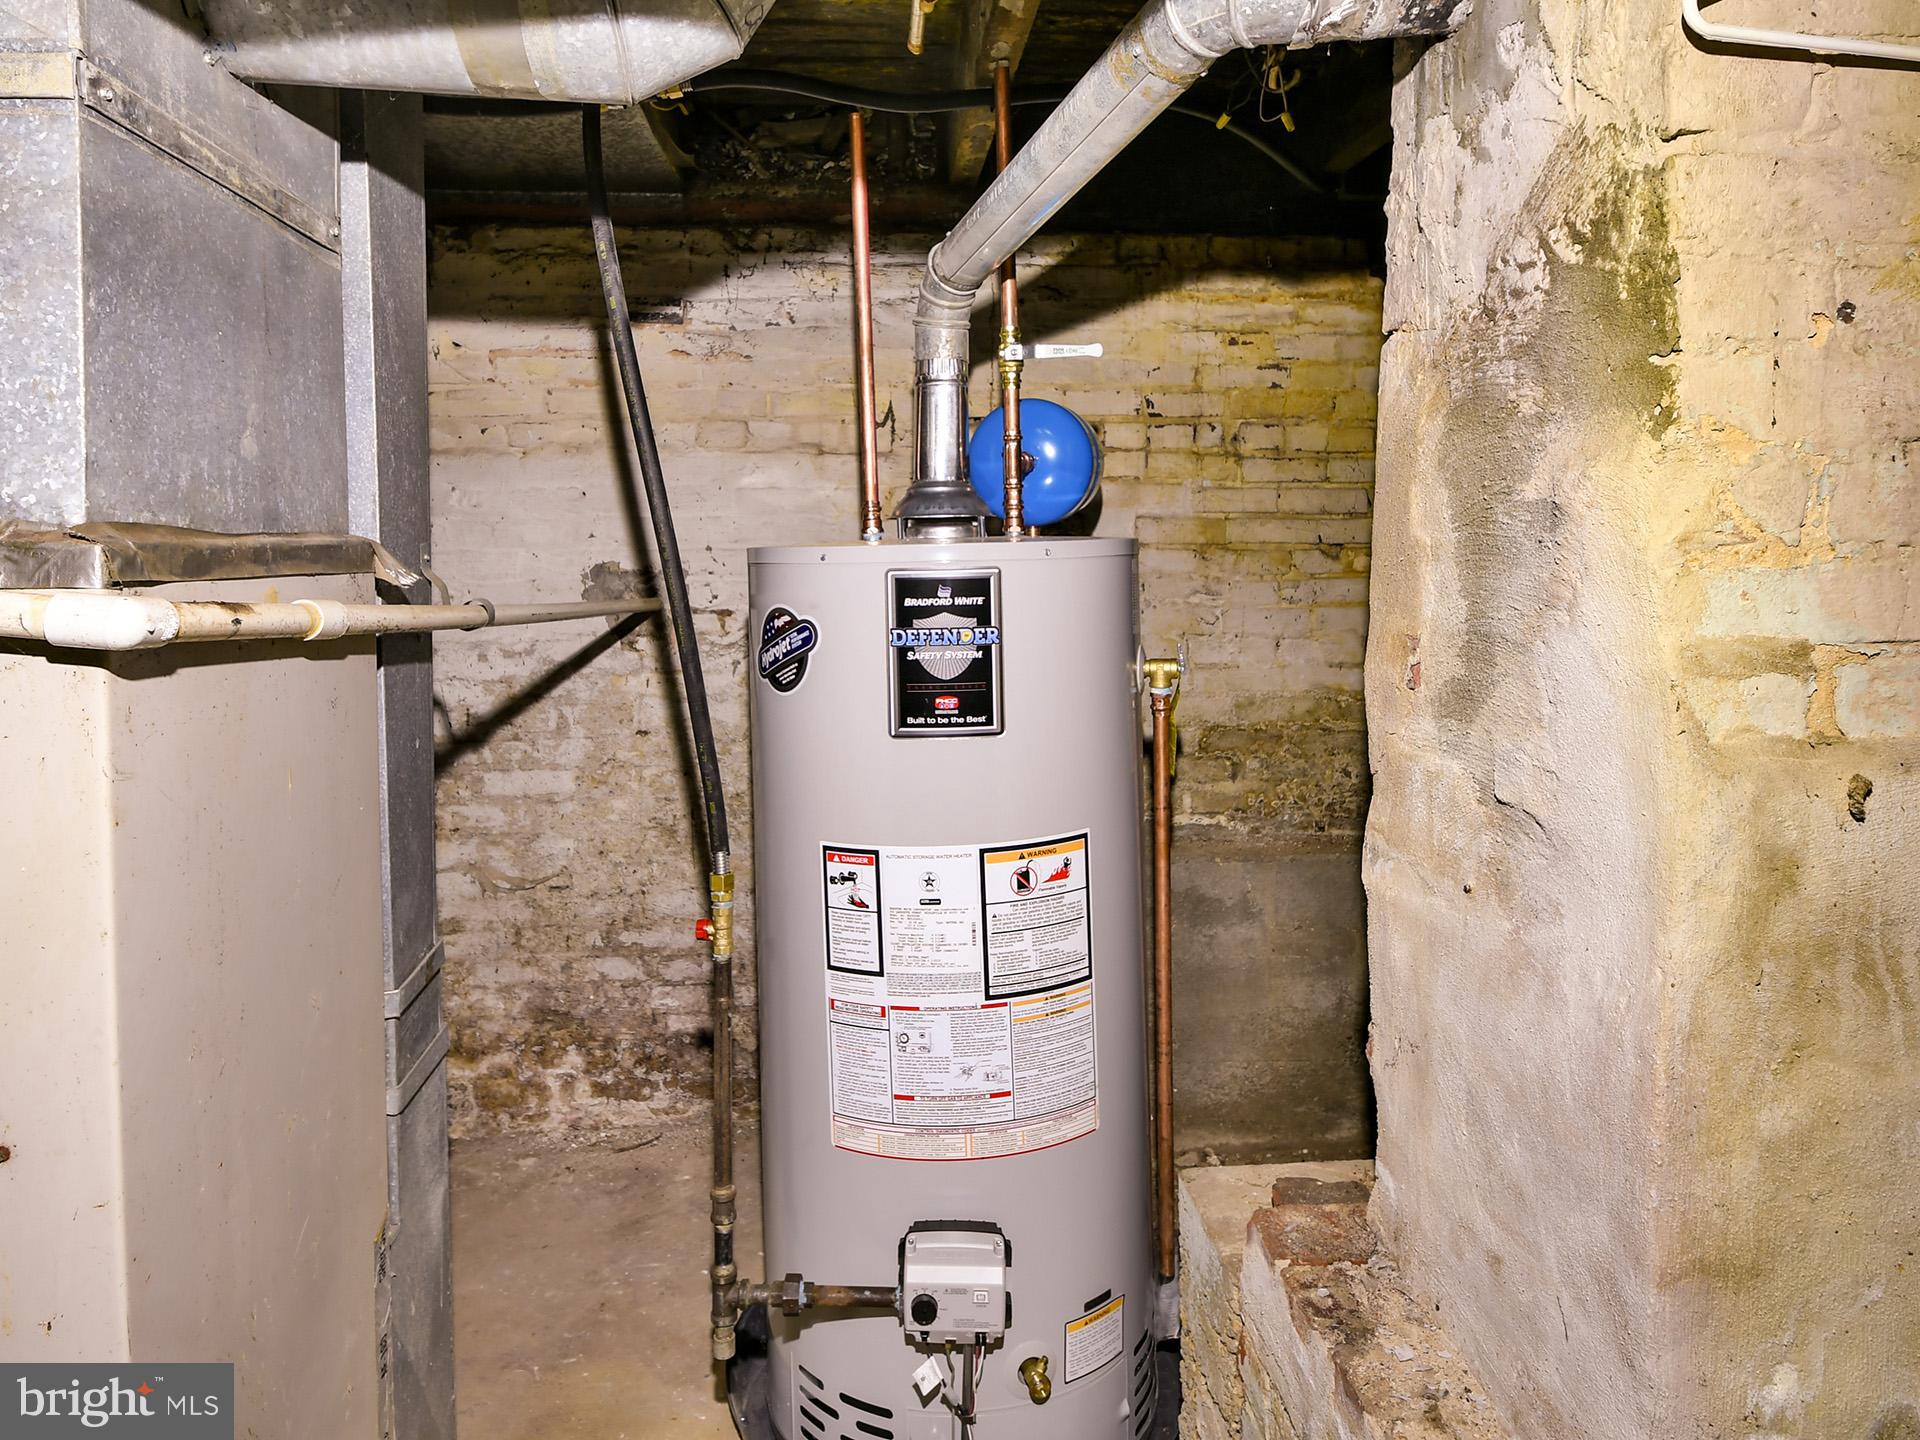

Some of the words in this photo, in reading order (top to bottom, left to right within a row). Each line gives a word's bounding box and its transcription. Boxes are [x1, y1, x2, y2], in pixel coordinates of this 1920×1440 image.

[904, 597, 953, 606] BRADFORD
[954, 596, 984, 605] WHITE
[891, 627, 1000, 647] DEFENDER
[906, 651, 943, 660] SAFETY
[944, 650, 982, 659] SYSTEM
[906, 716, 925, 724] Built
[937, 716, 948, 724] be
[966, 715, 986, 723] Best
[1026, 847, 1057, 858] WARNING
[841, 856, 869, 864] DANGER
